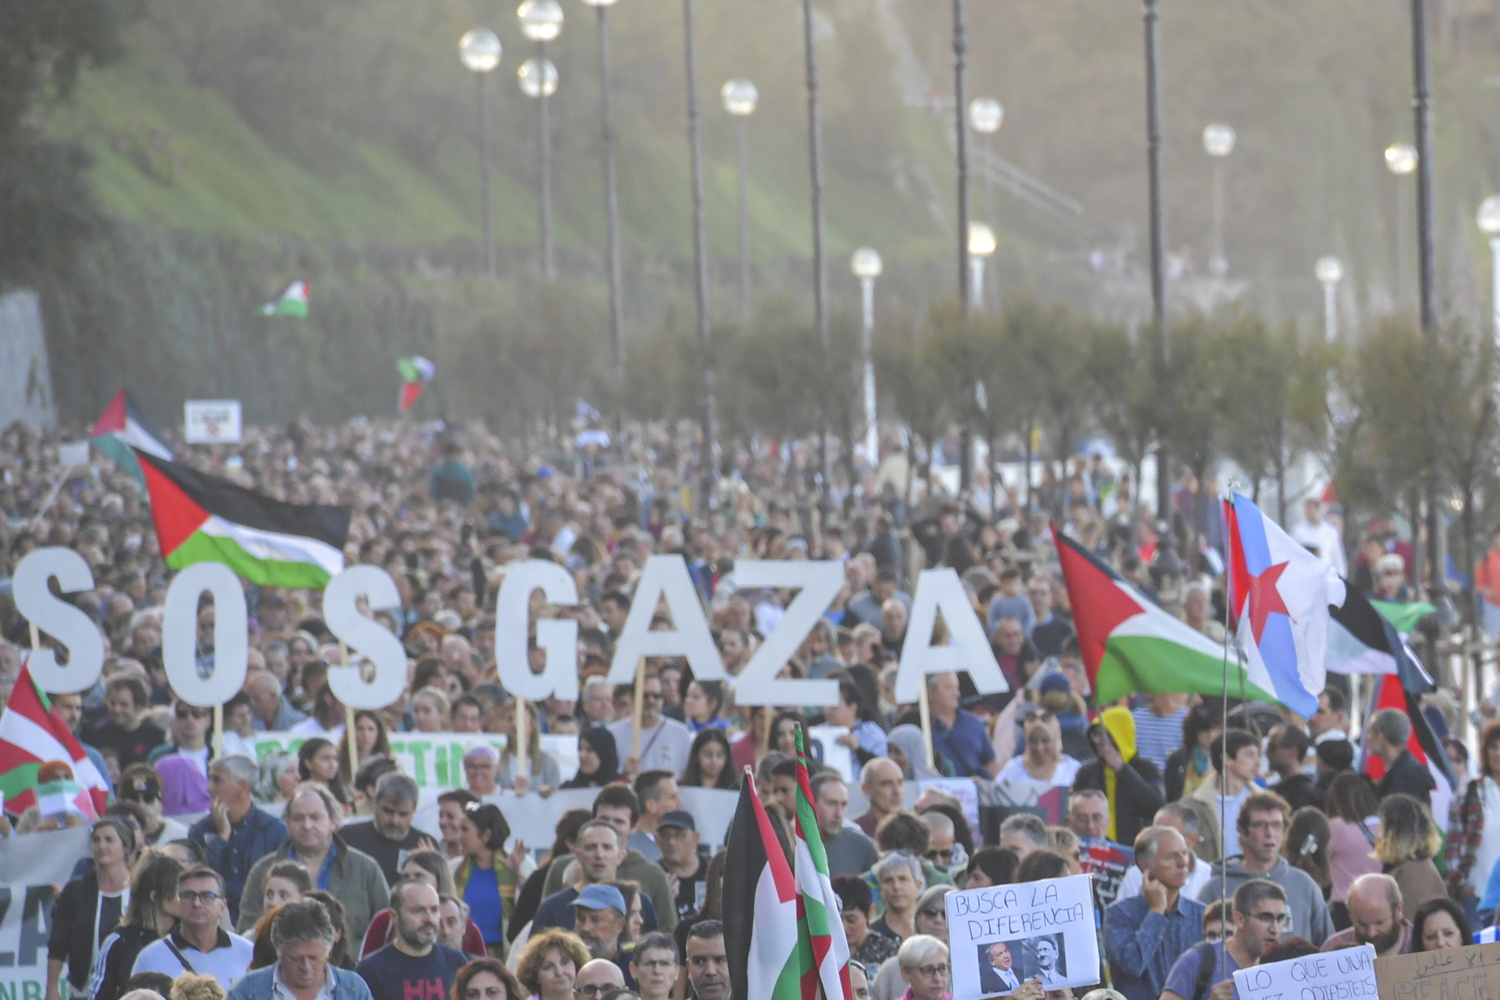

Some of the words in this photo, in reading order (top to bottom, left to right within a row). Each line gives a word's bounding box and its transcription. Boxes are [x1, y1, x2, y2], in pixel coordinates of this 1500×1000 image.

[495, 554, 1010, 706] GAZA
[955, 889, 1017, 917] BUSCA
[1031, 884, 1058, 908] LA
[967, 902, 1084, 941] DIFERENCIA
[1245, 969, 1272, 993] LO
[1290, 958, 1329, 983] QUE
[1336, 951, 1372, 975] UNA
